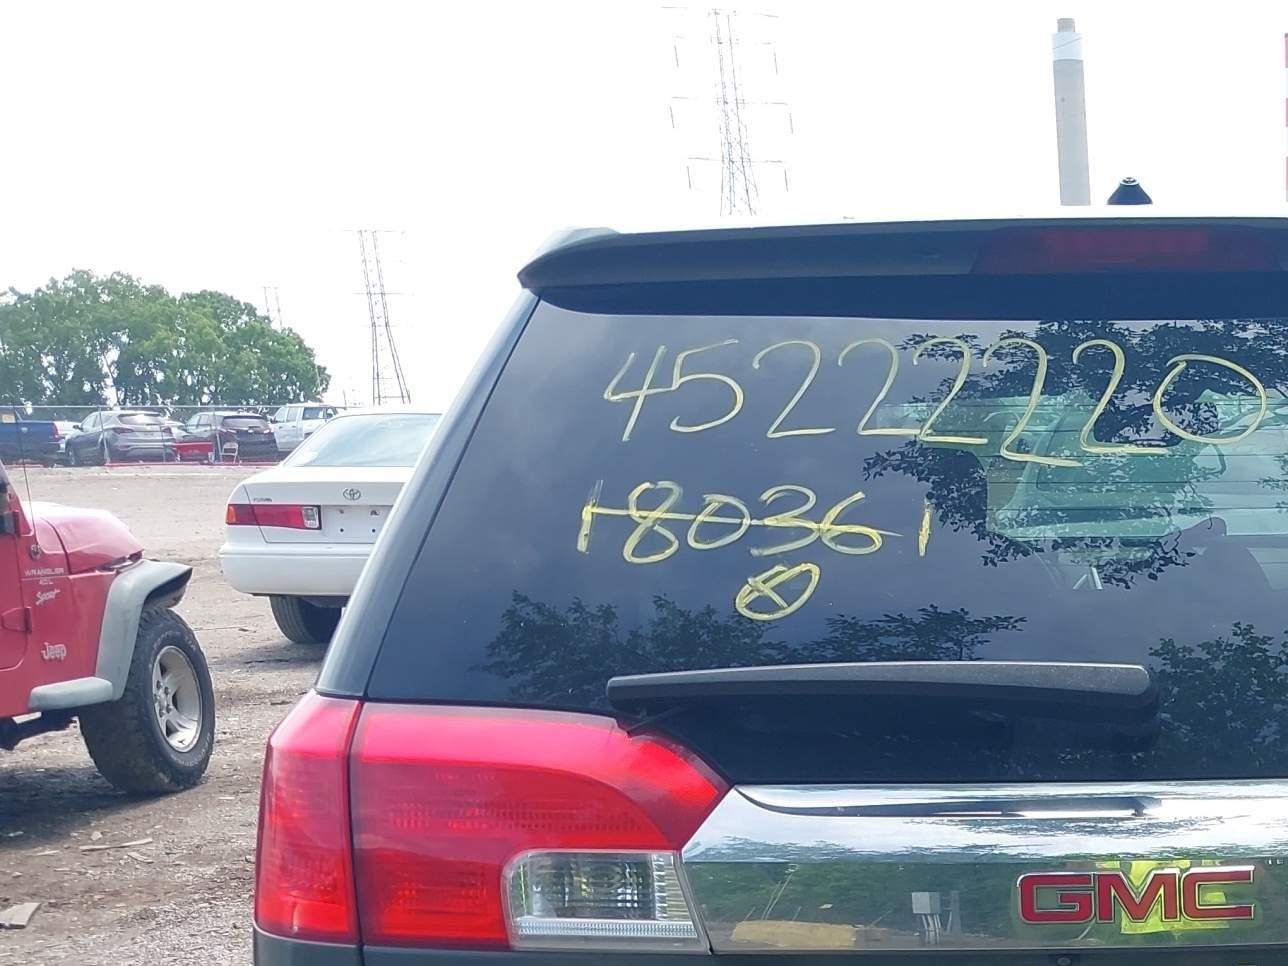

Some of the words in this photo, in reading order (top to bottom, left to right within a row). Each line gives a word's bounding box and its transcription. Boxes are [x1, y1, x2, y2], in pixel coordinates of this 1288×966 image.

[603, 338, 1268, 467] 45222220
[24, 567, 65, 577] WRANGLER
[41, 641, 67, 661] Jeep
[1016, 865, 1256, 925] GMC
